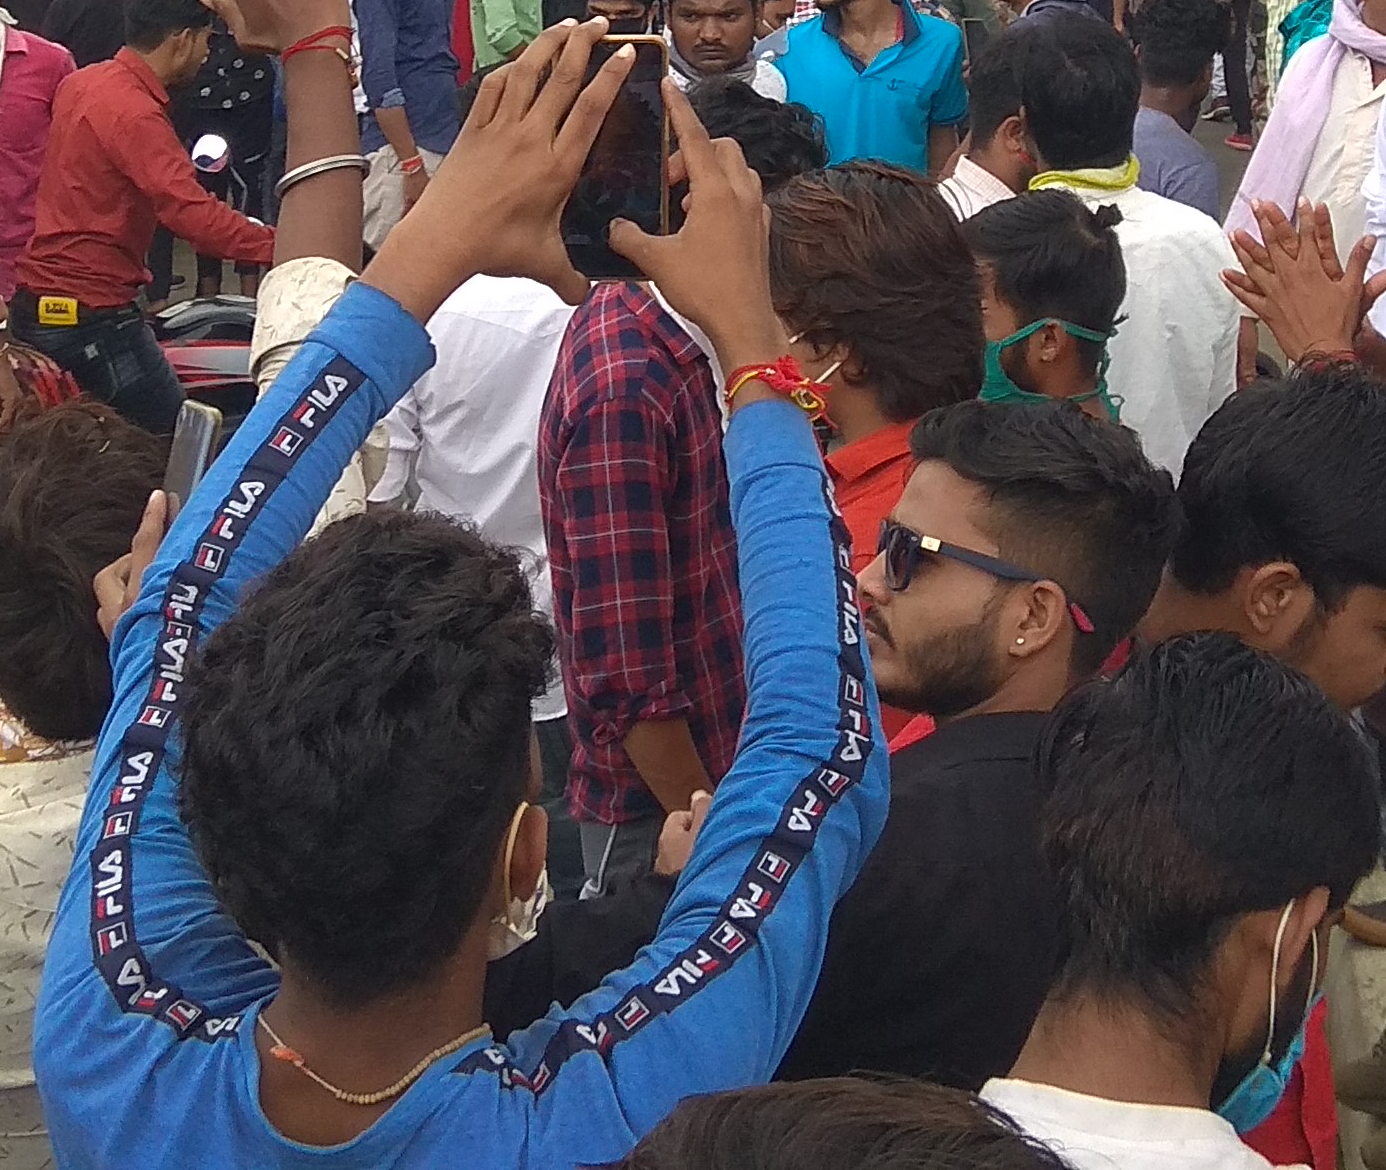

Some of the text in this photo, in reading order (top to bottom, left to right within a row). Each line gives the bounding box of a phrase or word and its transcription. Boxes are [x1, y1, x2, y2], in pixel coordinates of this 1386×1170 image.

[292, 374, 349, 429] FILA
[212, 481, 266, 540] FILA
[153, 638, 189, 702] FILA
[94, 849, 124, 921] FILA
[654, 948, 720, 997] FILA
